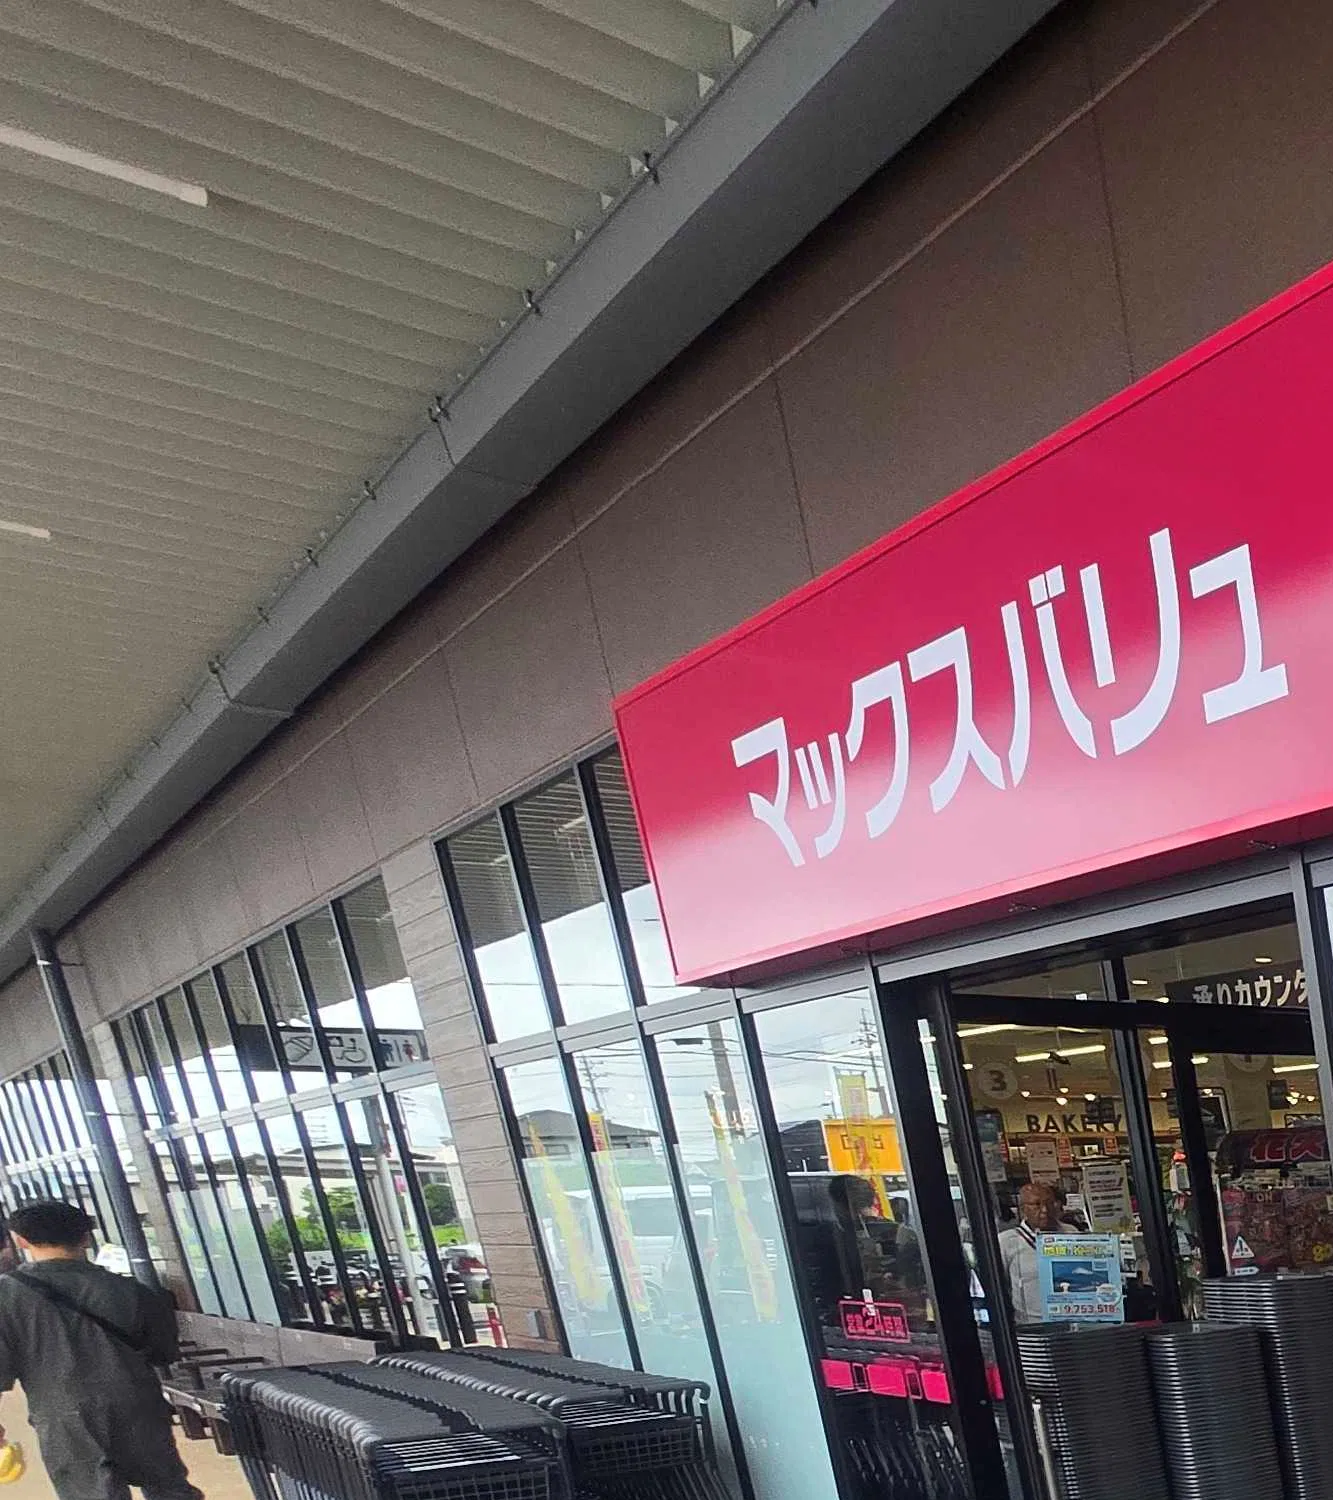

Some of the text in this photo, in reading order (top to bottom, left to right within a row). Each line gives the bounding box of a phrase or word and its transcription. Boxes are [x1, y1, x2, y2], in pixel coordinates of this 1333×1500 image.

[731, 527, 1290, 868] マックスバリュ
